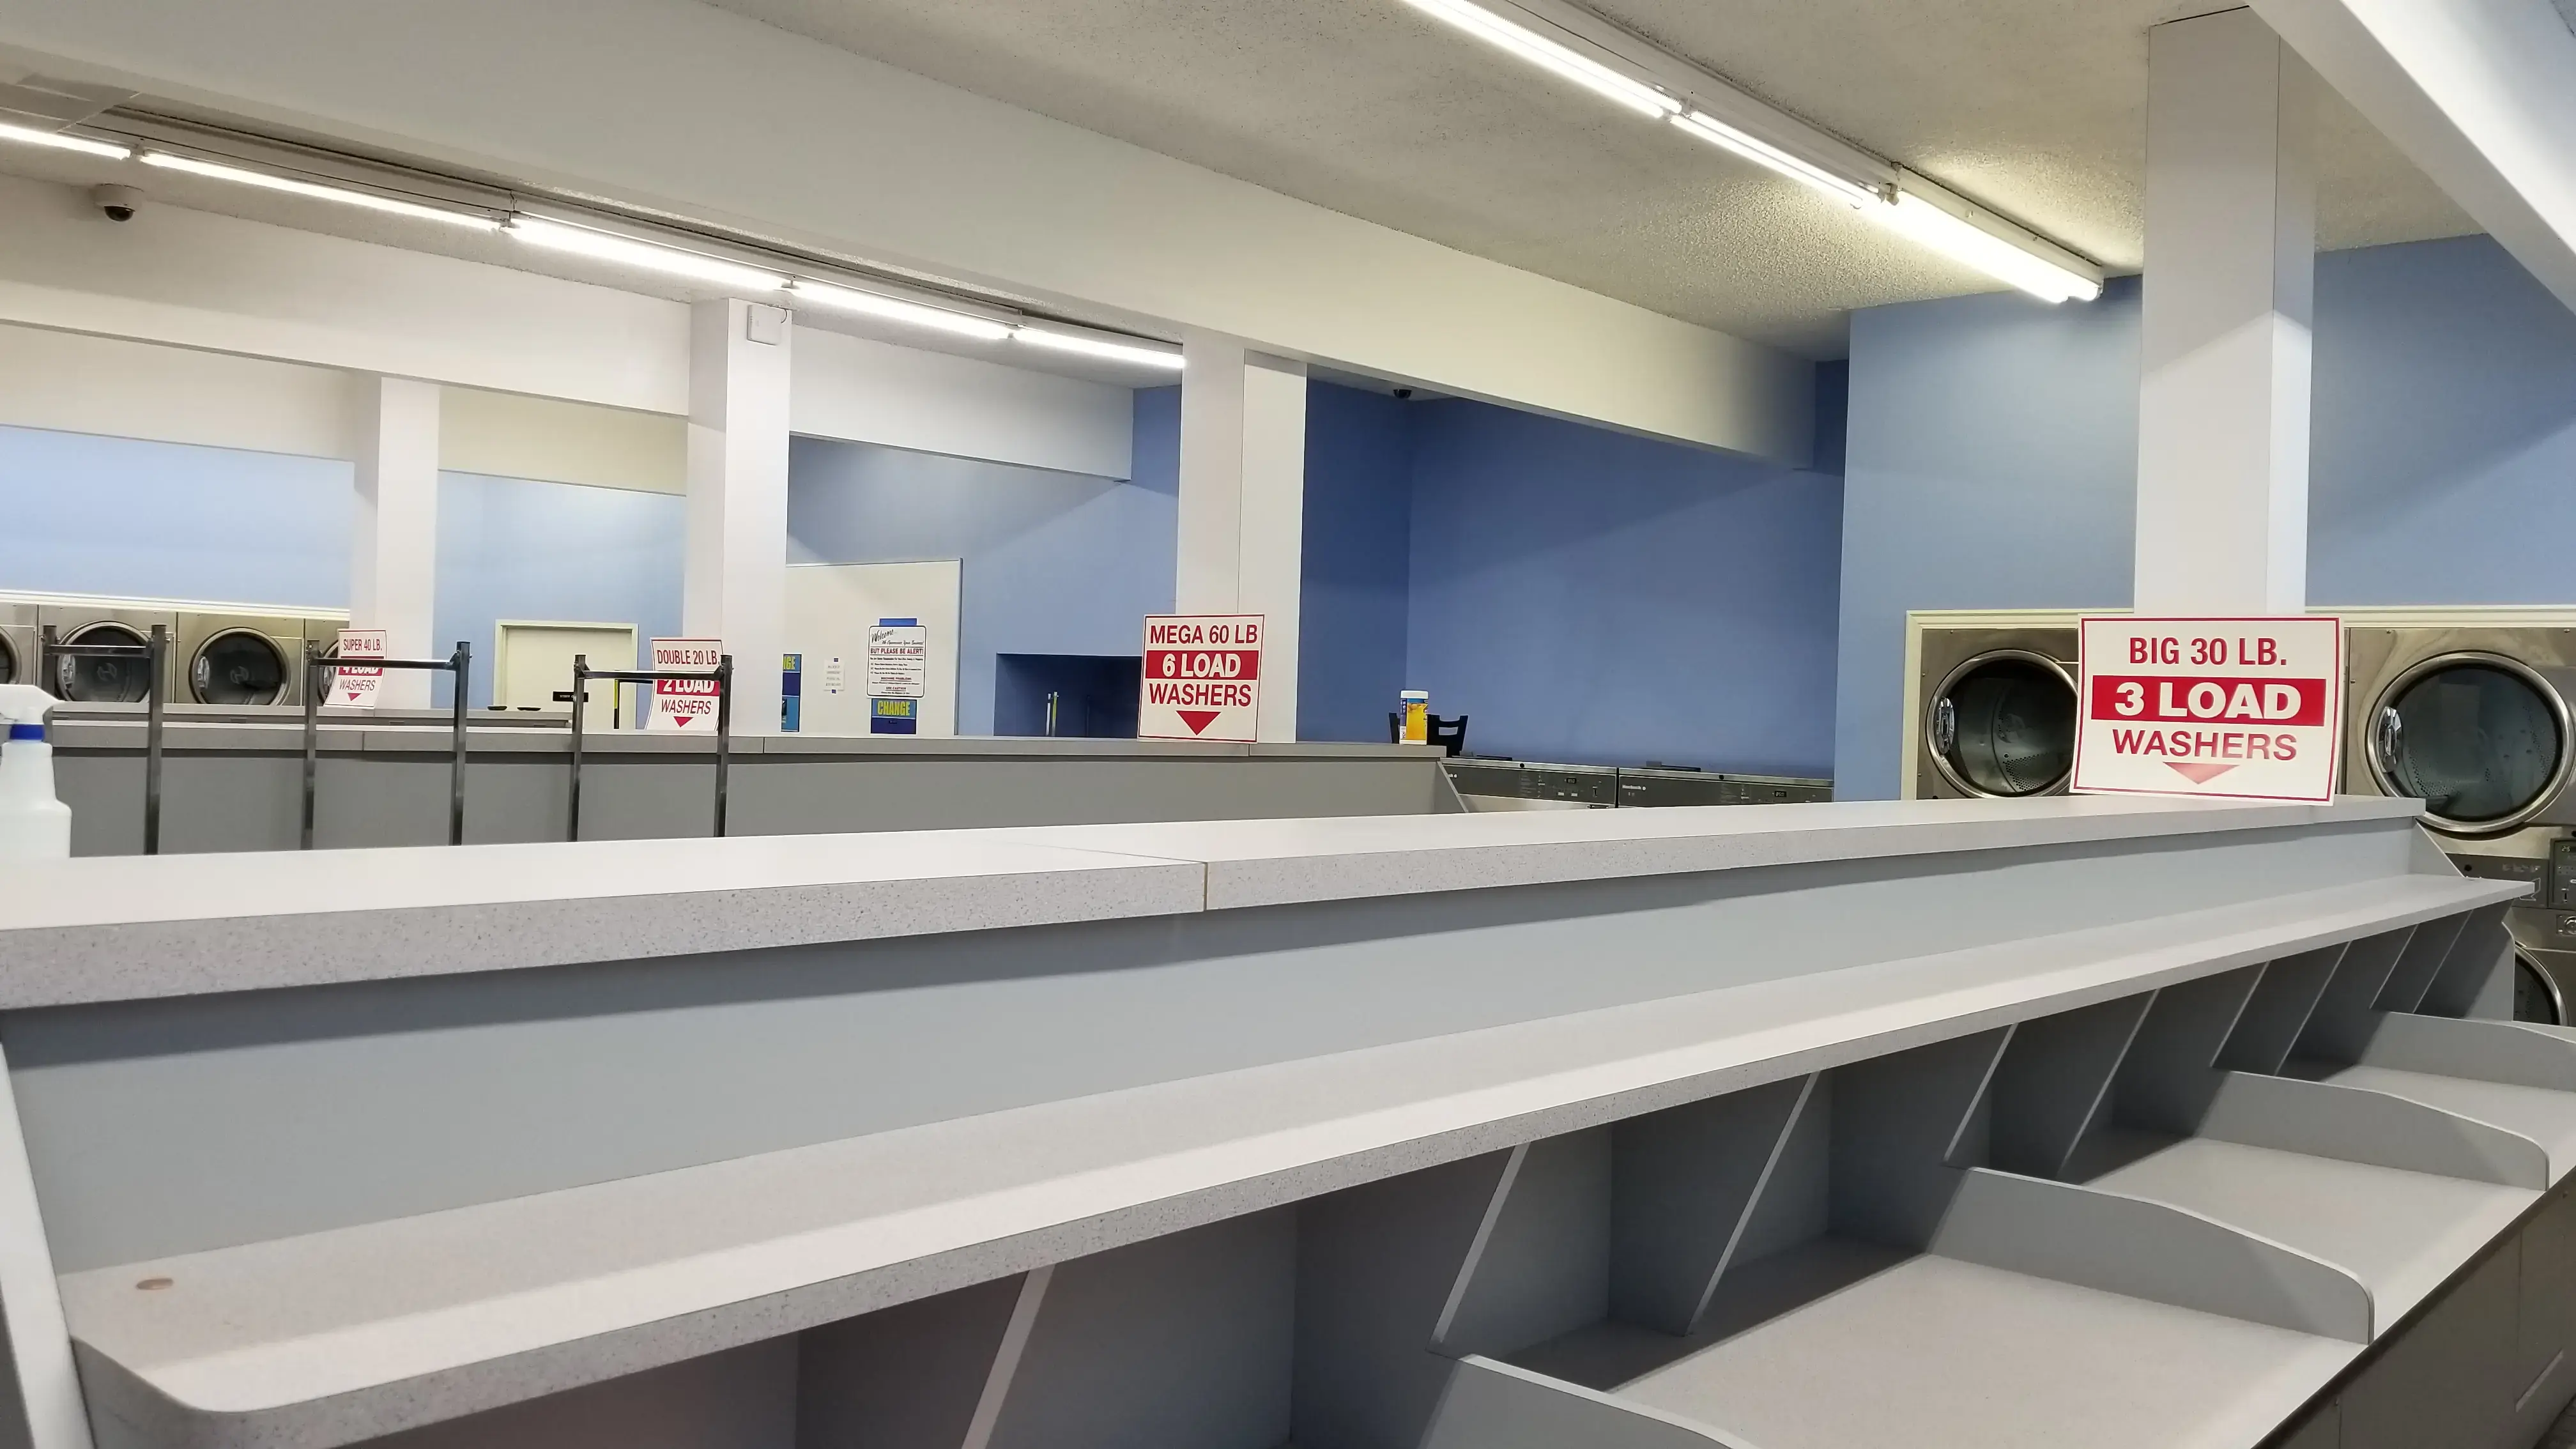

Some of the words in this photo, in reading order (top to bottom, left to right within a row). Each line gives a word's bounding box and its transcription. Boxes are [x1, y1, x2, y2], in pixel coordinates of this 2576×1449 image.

[1150, 625, 1204, 644] MEGA
[1209, 625, 1229, 644] 60
[1235, 625, 1257, 644] LB
[343, 639, 362, 651] SUPER
[364, 639, 371, 650] 40
[373, 639, 382, 650] LB.
[2129, 637, 2179, 665] BIG
[2191, 637, 2227, 665] 30
[2239, 638, 2287, 666] LB.
[657, 650, 691, 664] DOUBLE
[693, 650, 703, 664] 20
[1163, 653, 1176, 677] 6
[1181, 653, 1241, 677] LOAD
[339, 679, 376, 691] WASHERS
[675, 679, 715, 693] LOAD
[1149, 683, 1252, 707] WASHERS
[2115, 682, 2144, 716] 3
[2159, 682, 2301, 719] LOAD
[661, 699, 712, 714] WASHERS
[877, 701, 910, 716] CHANGE
[2112, 729, 2297, 761] WASHERS
